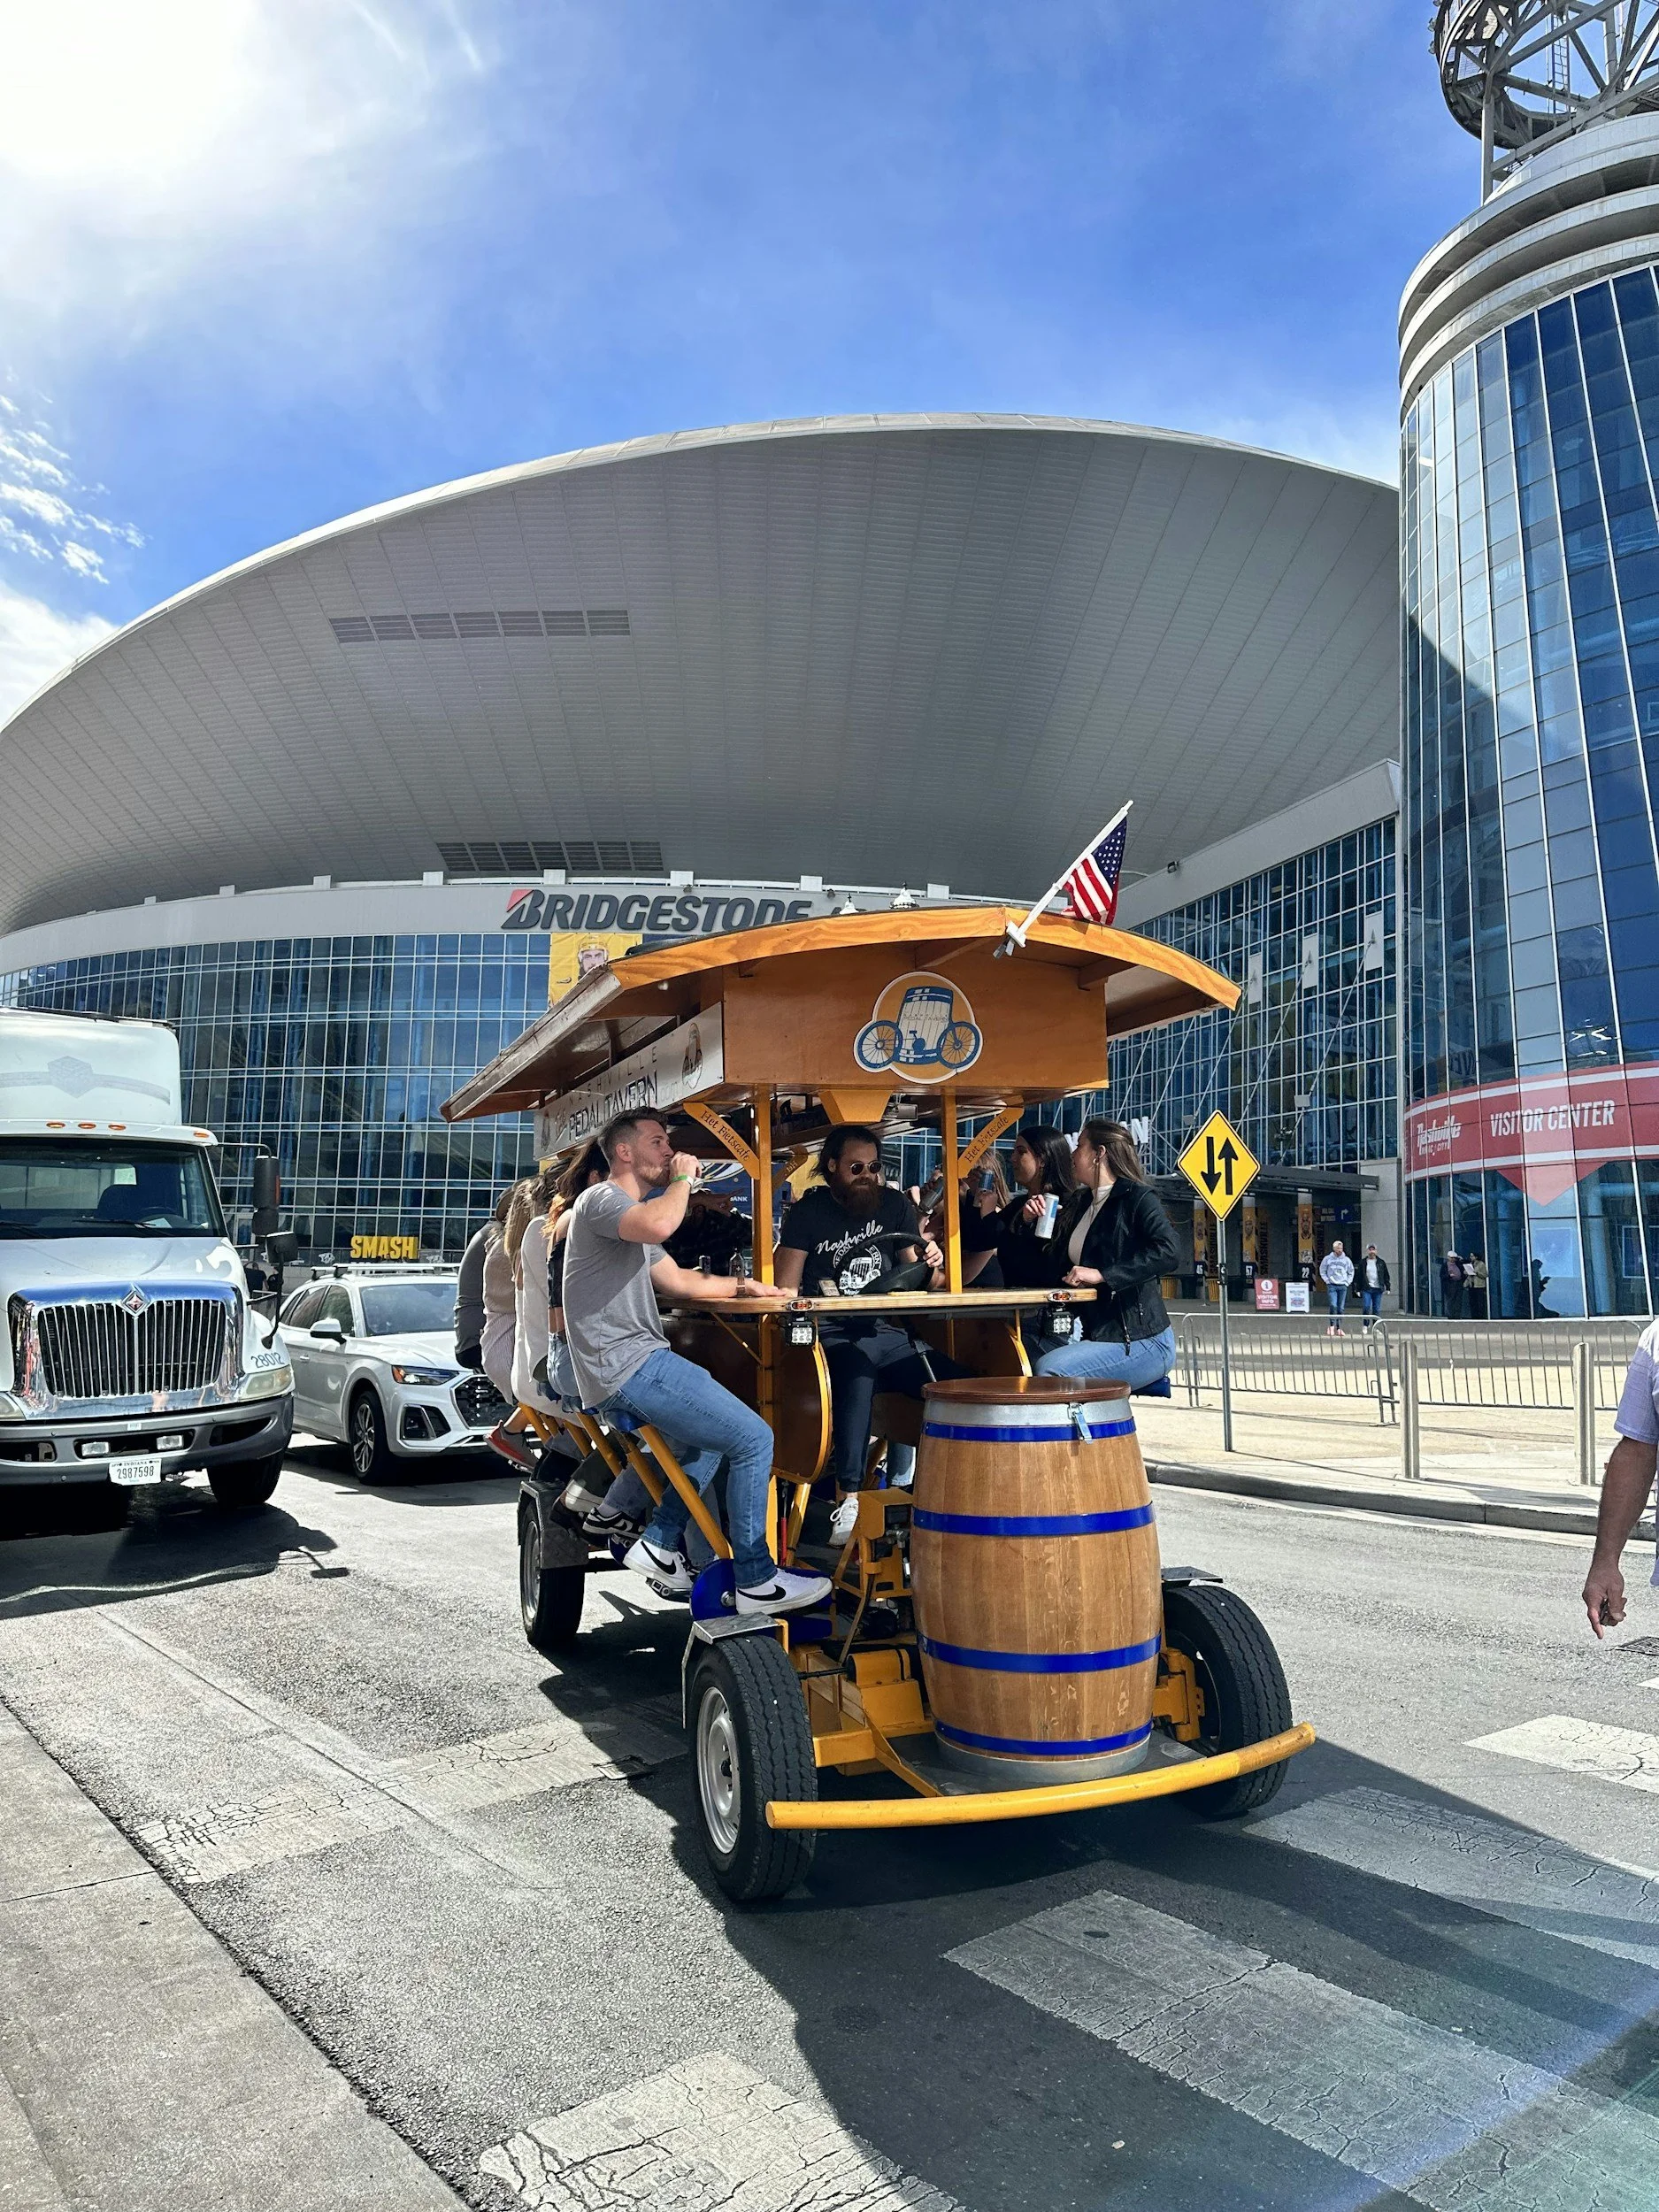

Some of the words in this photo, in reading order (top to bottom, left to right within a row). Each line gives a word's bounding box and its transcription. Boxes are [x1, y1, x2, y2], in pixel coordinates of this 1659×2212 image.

[501, 889, 812, 933] BRIDGESTONE
[700, 1110, 718, 1129] Het
[1490, 1108, 1544, 1138] VISITOR
[1548, 1100, 1616, 1132] CENTER
[964, 1145, 980, 1164] Het
[815, 1220, 883, 1255] Nashville
[349, 1235, 419, 1260] SMASH
[1302, 1267, 1310, 1279] 22
[250, 1352, 285, 1369] 28012
[117, 1465, 154, 1479] 2987598
